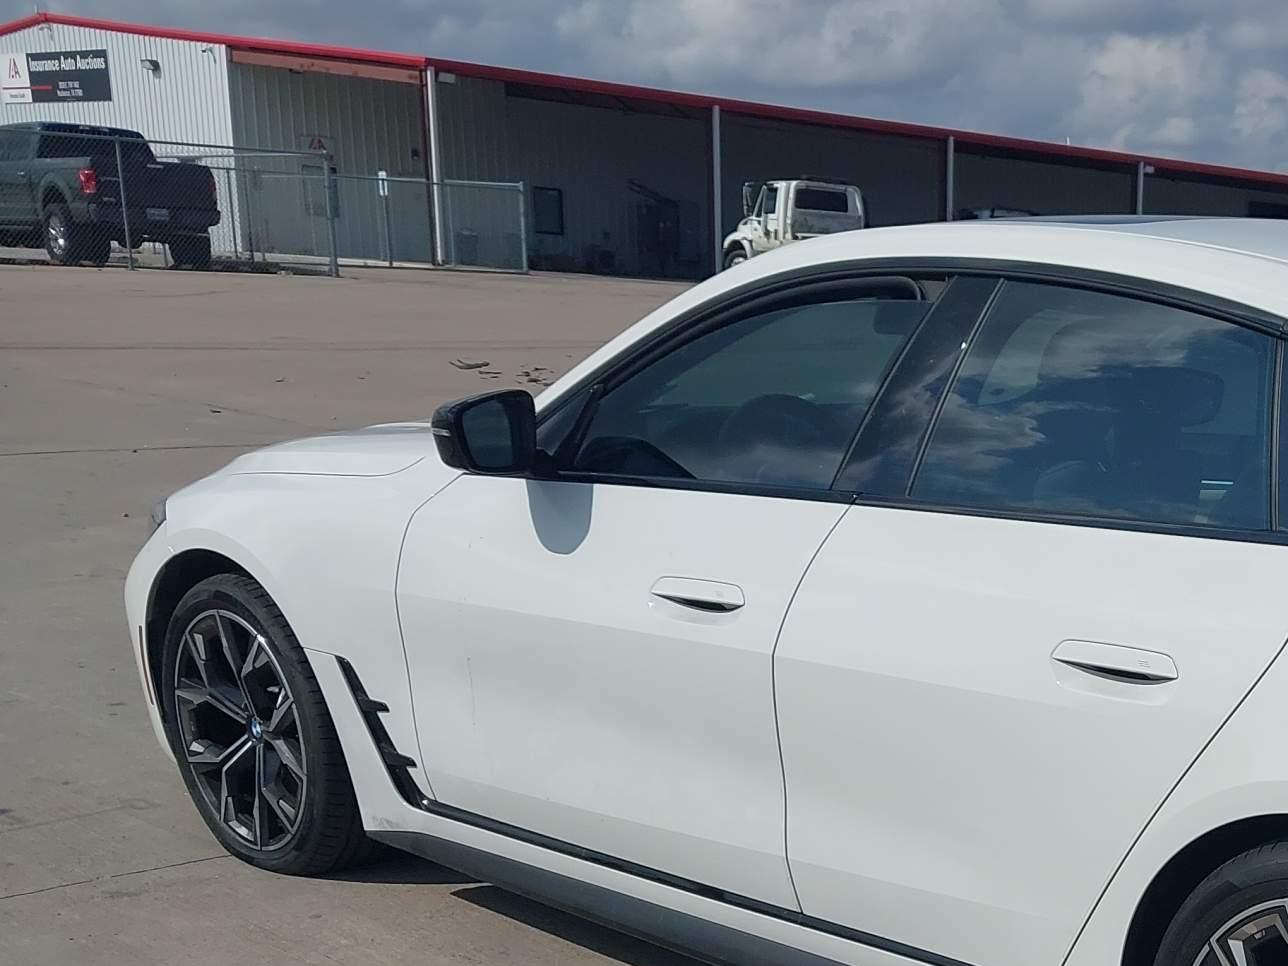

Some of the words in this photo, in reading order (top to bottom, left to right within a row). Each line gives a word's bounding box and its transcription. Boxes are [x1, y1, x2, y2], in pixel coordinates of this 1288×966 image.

[28, 56, 60, 72] Insurance
[60, 55, 76, 71] Auto
[76, 54, 106, 70] Auctions
